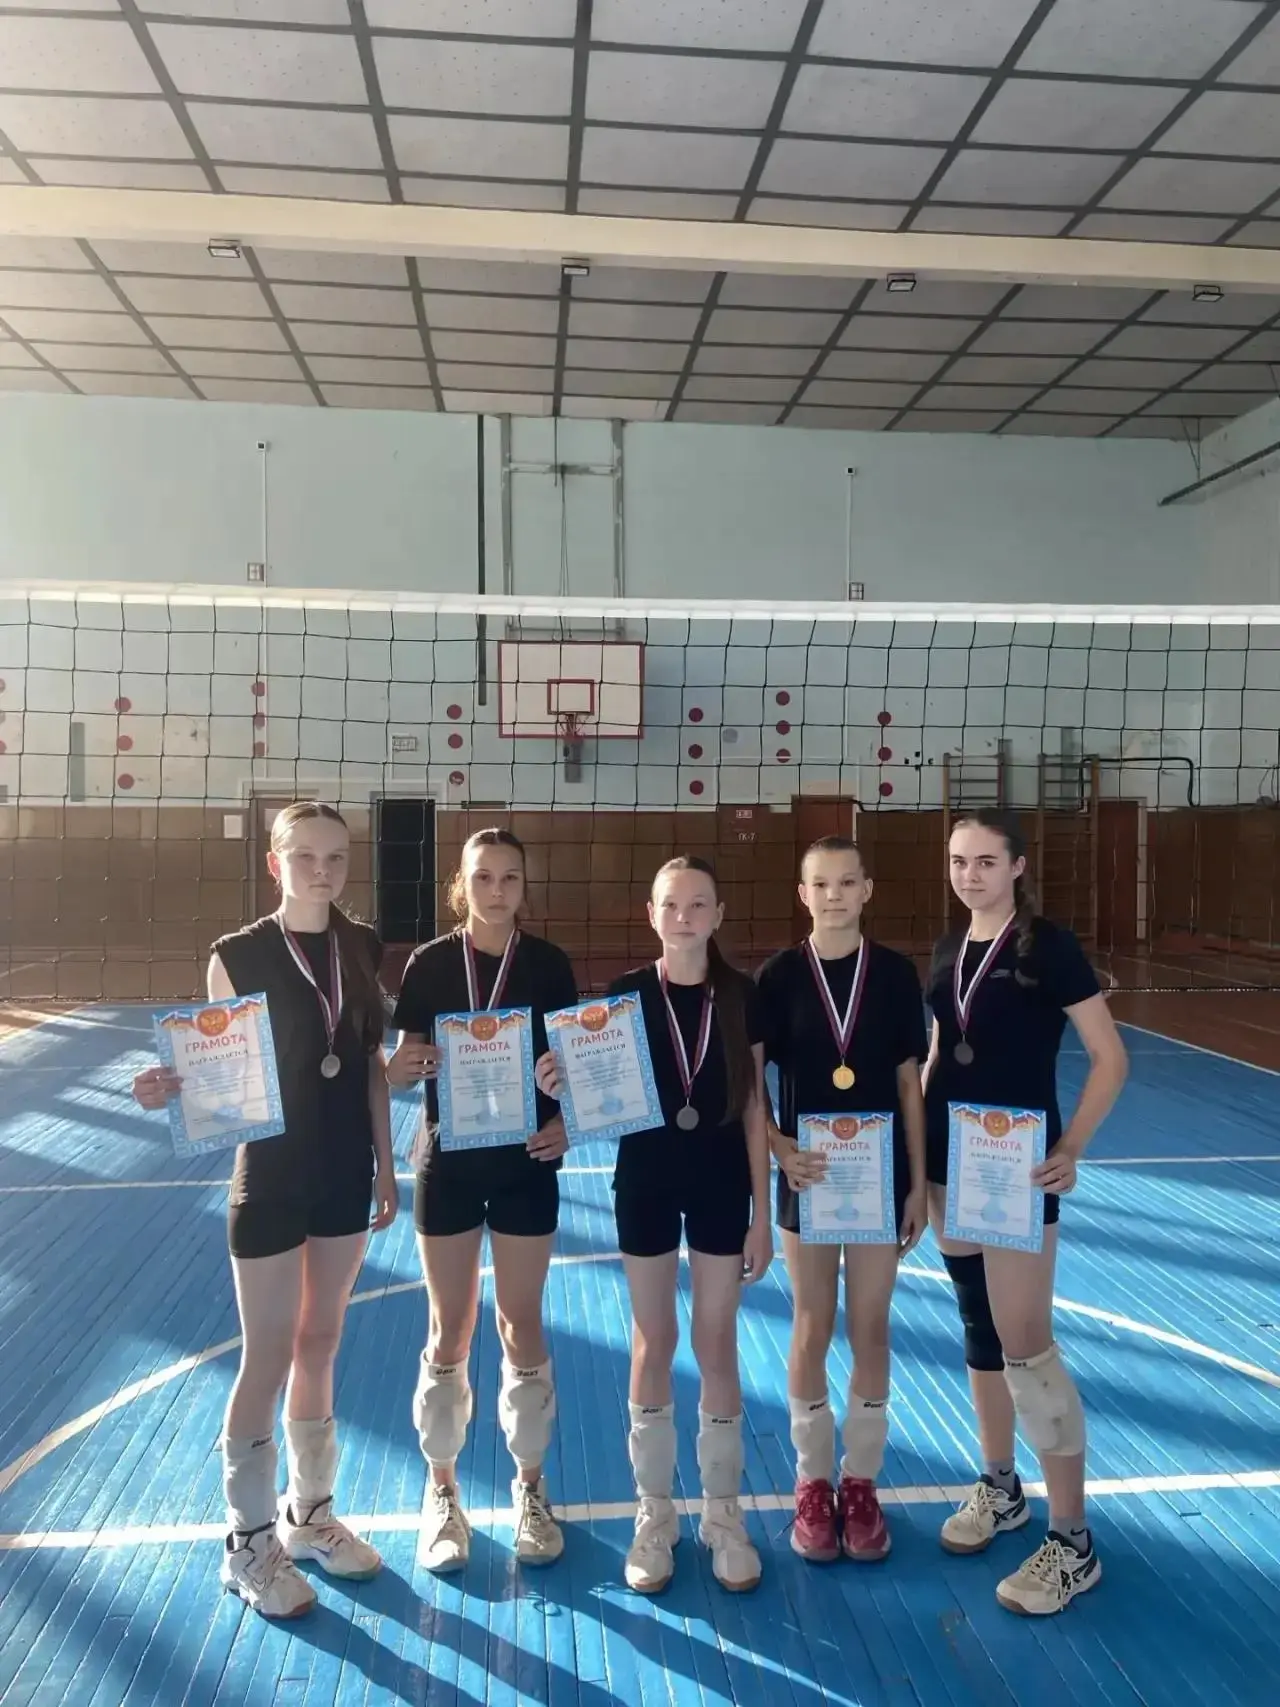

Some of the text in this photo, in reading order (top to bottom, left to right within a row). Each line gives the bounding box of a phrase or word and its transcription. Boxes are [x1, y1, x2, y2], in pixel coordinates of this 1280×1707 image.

[185, 1033, 248, 1054] ГРАМОТА
[571, 1028, 625, 1049] ГРАМОТА
[458, 1040, 511, 1054] ГРАМОТА
[820, 1141, 871, 1151] ГРАМОТА
[969, 1136, 1022, 1152] ГРАМОТА
